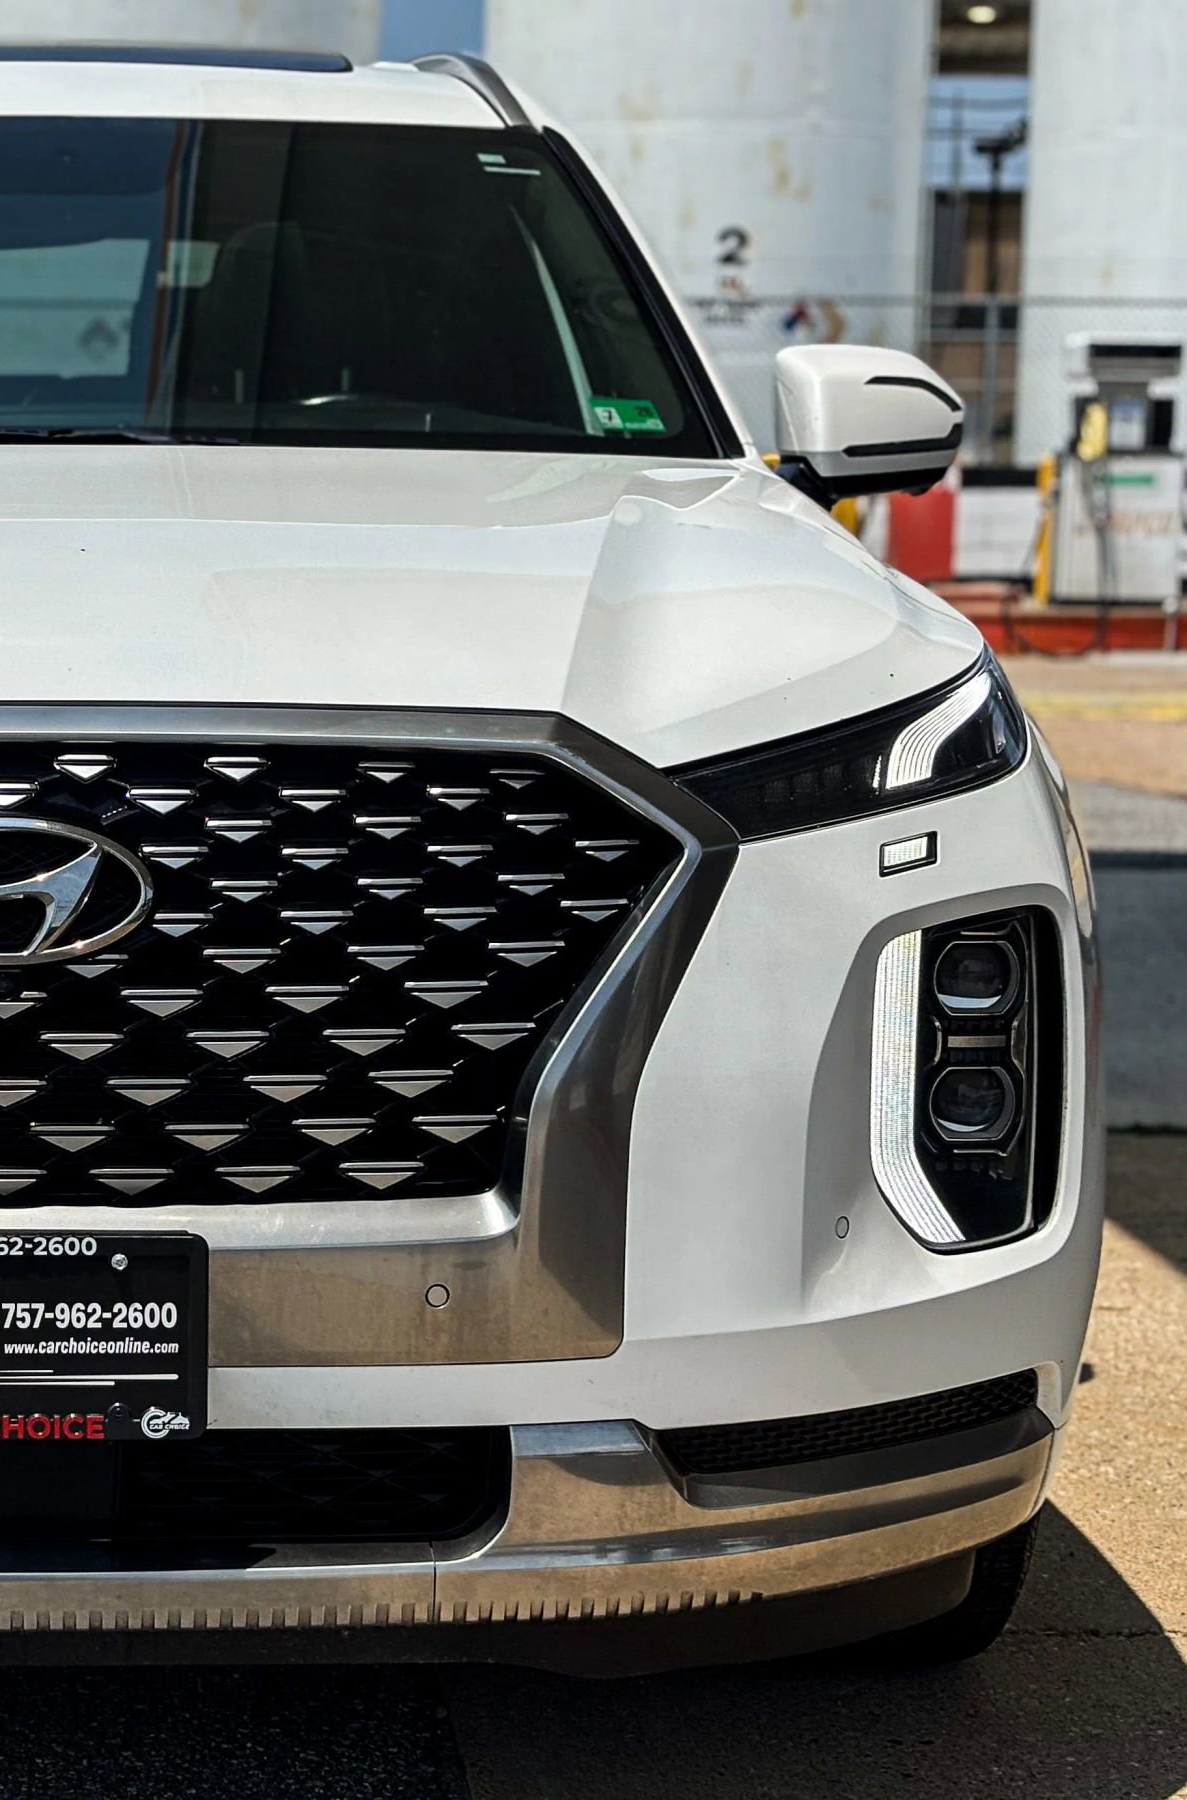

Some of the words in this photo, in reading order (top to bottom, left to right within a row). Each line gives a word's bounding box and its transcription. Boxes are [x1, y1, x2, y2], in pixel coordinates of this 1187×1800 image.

[717, 227, 749, 266] 2
[1, 1302, 178, 1329] 757-962-2600
[4, 1337, 180, 1354] www.carchoiceonline.com
